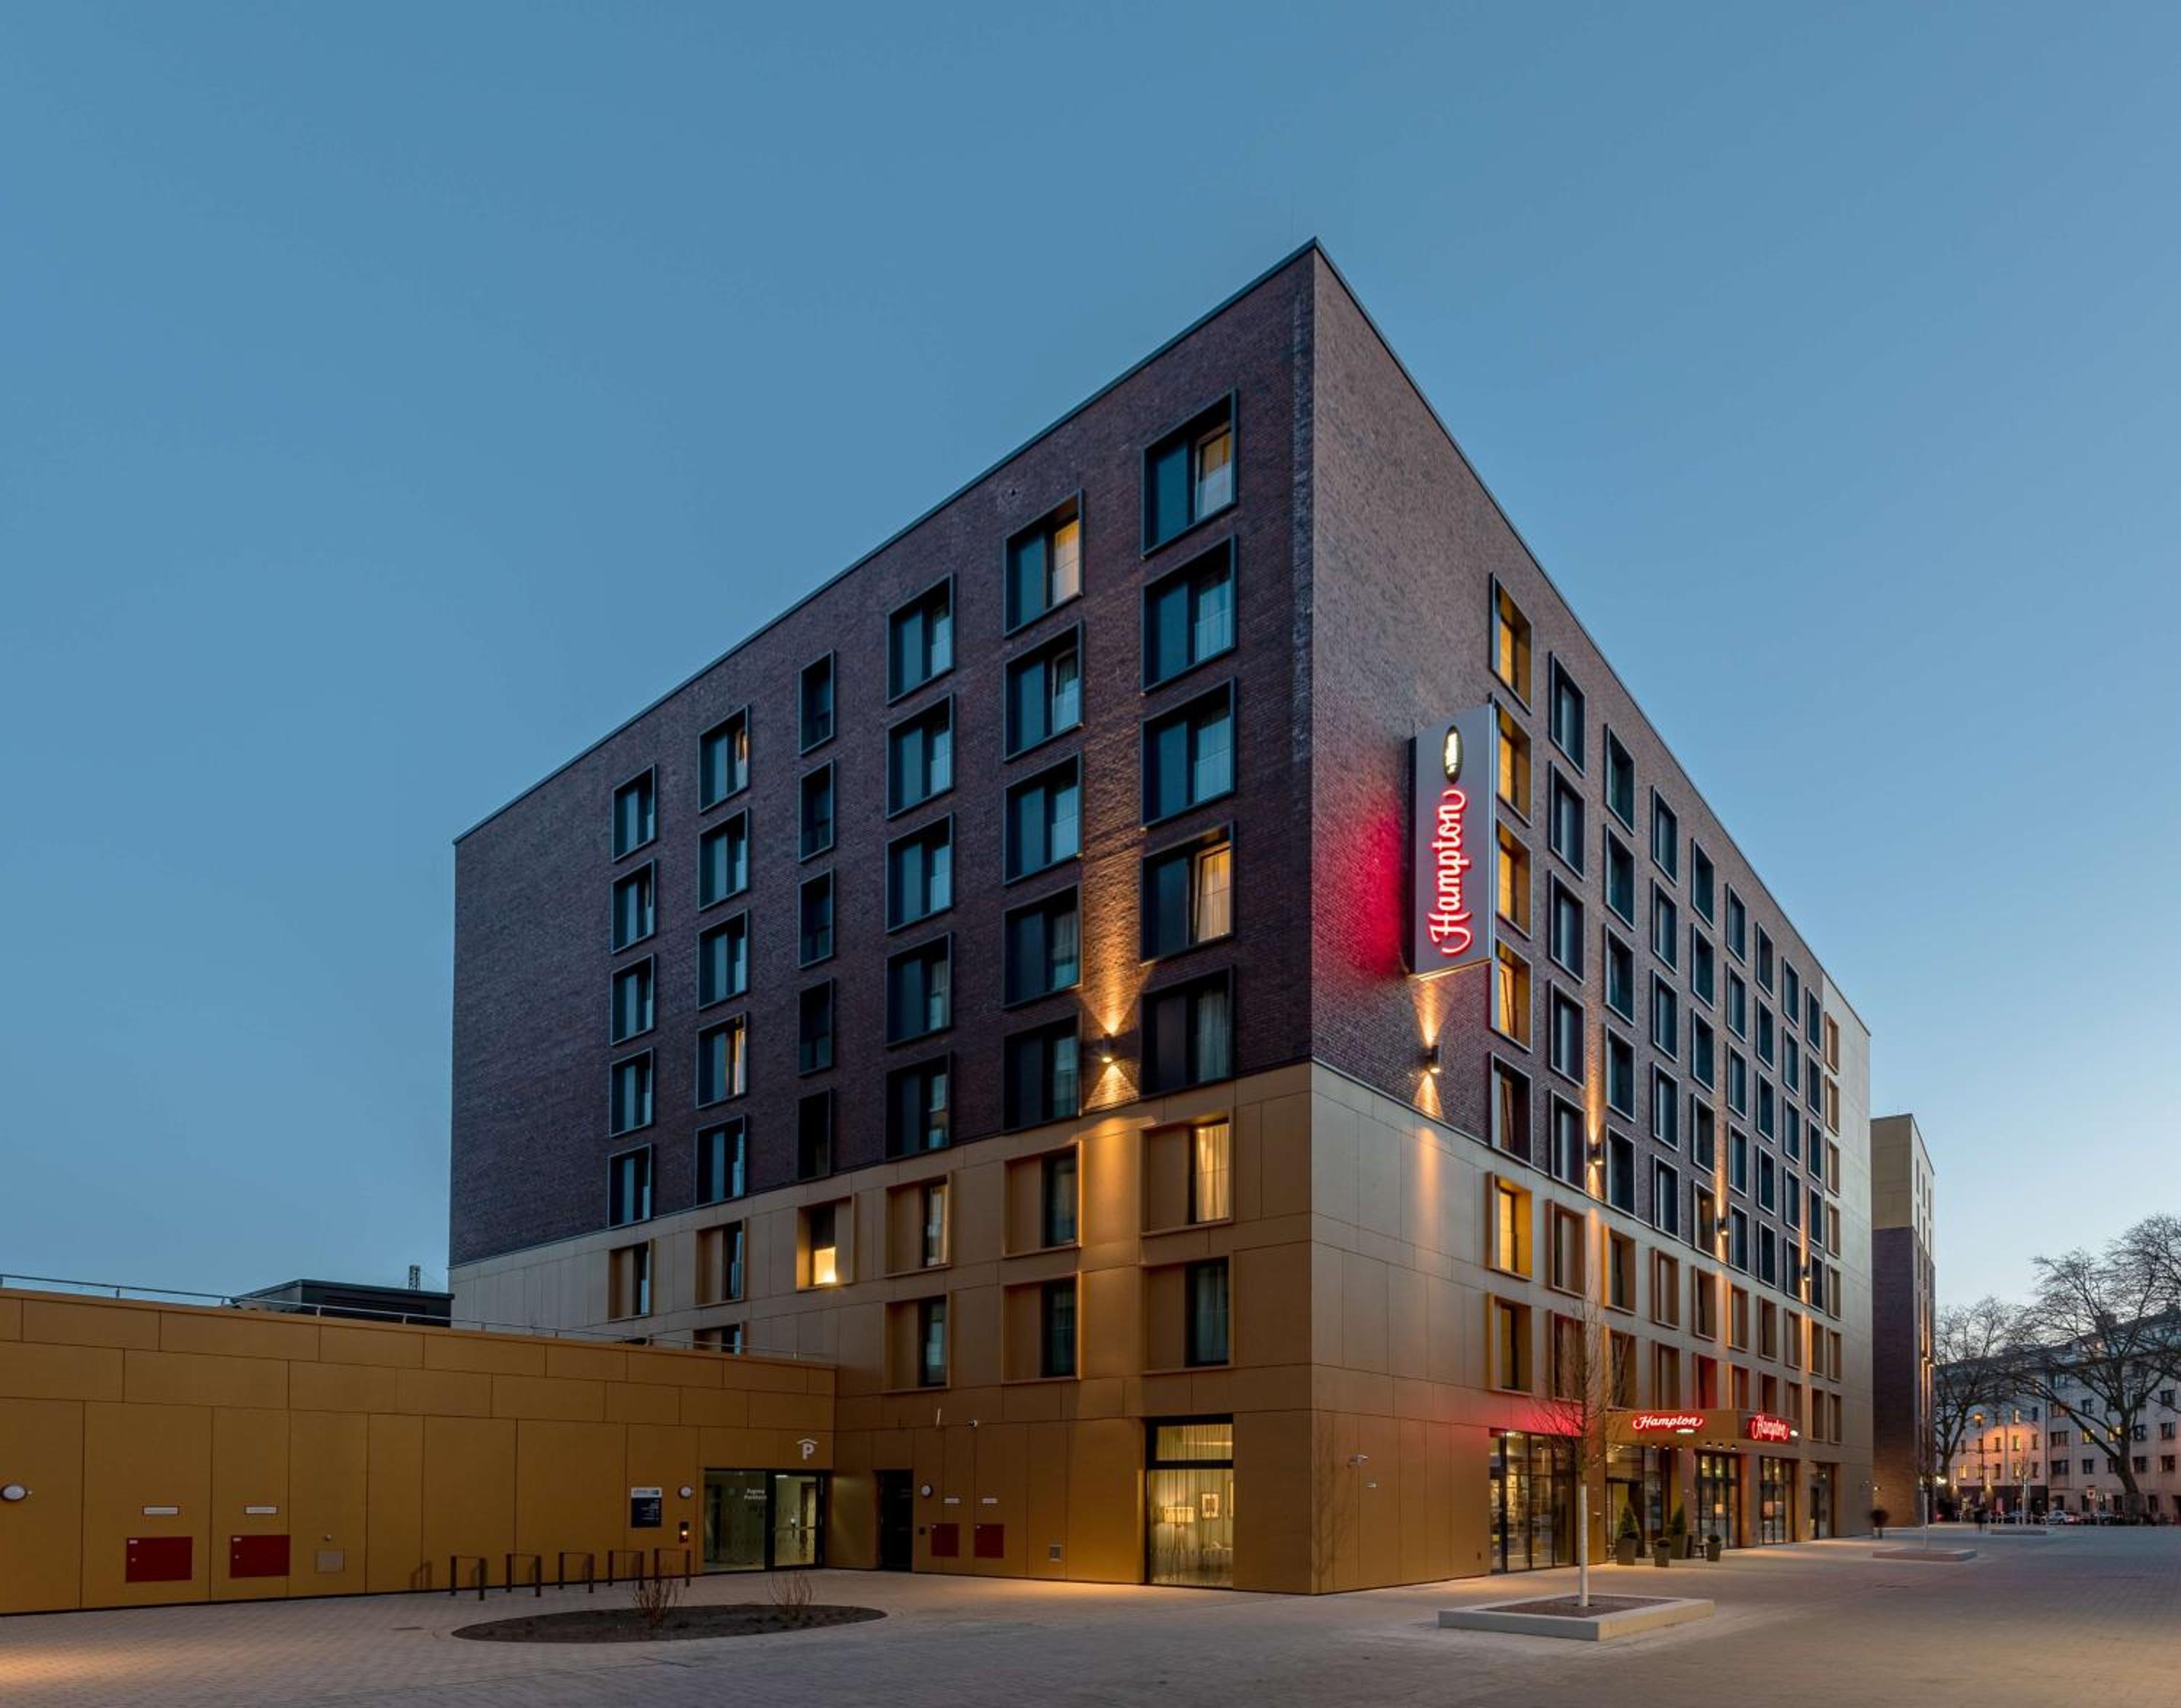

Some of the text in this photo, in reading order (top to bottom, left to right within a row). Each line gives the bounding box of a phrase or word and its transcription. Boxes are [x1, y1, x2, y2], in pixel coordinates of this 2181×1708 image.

[1429, 789, 1472, 954] Hampton
[1633, 1415, 1703, 1430] Hampton
[1751, 1414, 1789, 1441] Hampton
[802, 1443, 815, 1459] P
